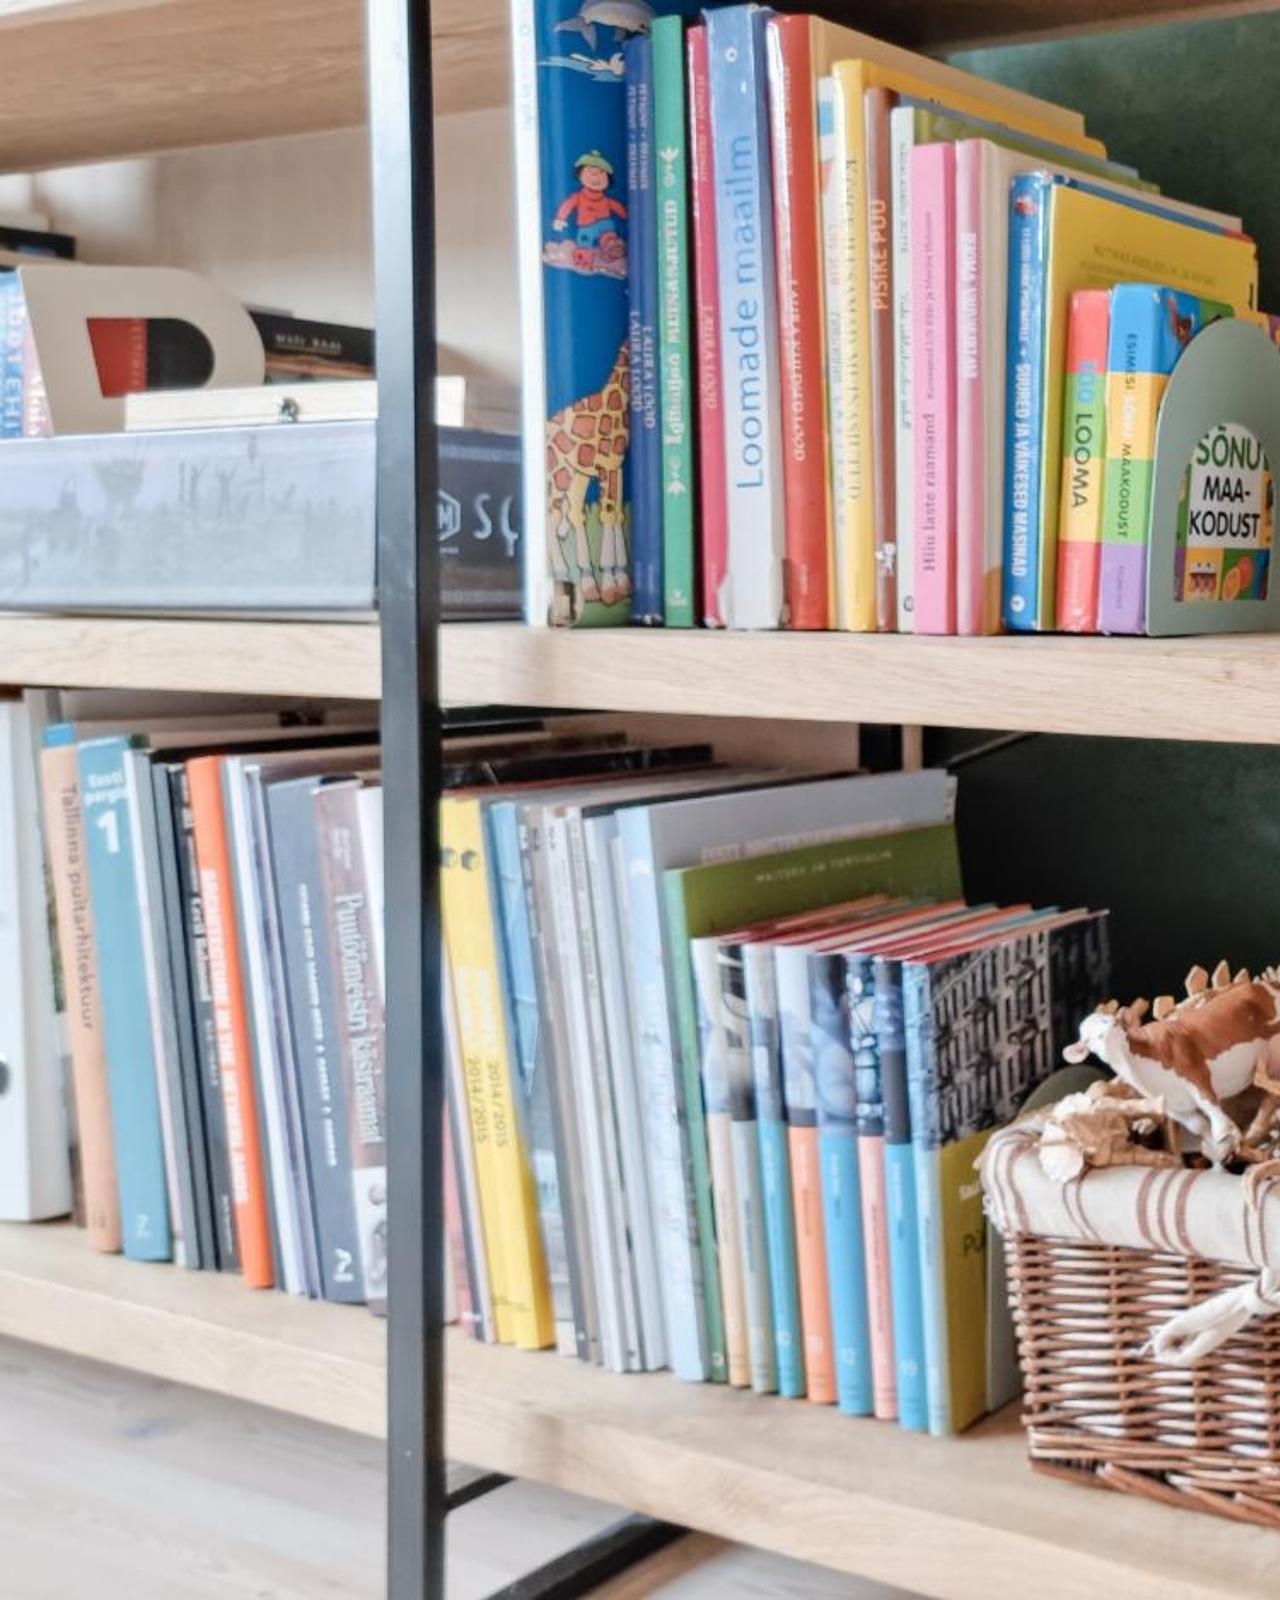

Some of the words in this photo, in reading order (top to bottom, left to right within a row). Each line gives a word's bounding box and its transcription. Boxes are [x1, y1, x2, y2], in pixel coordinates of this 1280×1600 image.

[725, 134, 758, 284] maailm
[870, 199, 887, 244] PUU
[871, 248, 889, 311] PISIKE
[1015, 364, 1031, 418] SUURED
[1124, 333, 1138, 390] ESIMESI
[730, 302, 762, 487] Loomade
[1015, 423, 1030, 438] JA
[1071, 413, 1094, 507] LOOMA
[1197, 426, 1261, 470] SÕNU
[923, 492, 936, 530] laste
[1118, 443, 1132, 537] MAAKODUST
[1203, 475, 1251, 503] MAA-
[922, 536, 936, 571] Hiiu
[1012, 512, 1028, 576] MASINAD
[1189, 510, 1261, 538] KODUST
[62, 786, 81, 867] Tallinna
[97, 810, 119, 853] 1
[67, 873, 96, 1029] puitarhitektuur
[350, 1036, 383, 1145] käsiraamat
[468, 1058, 489, 1144] 2014/2015
[487, 1063, 509, 1148] 2014/2015
